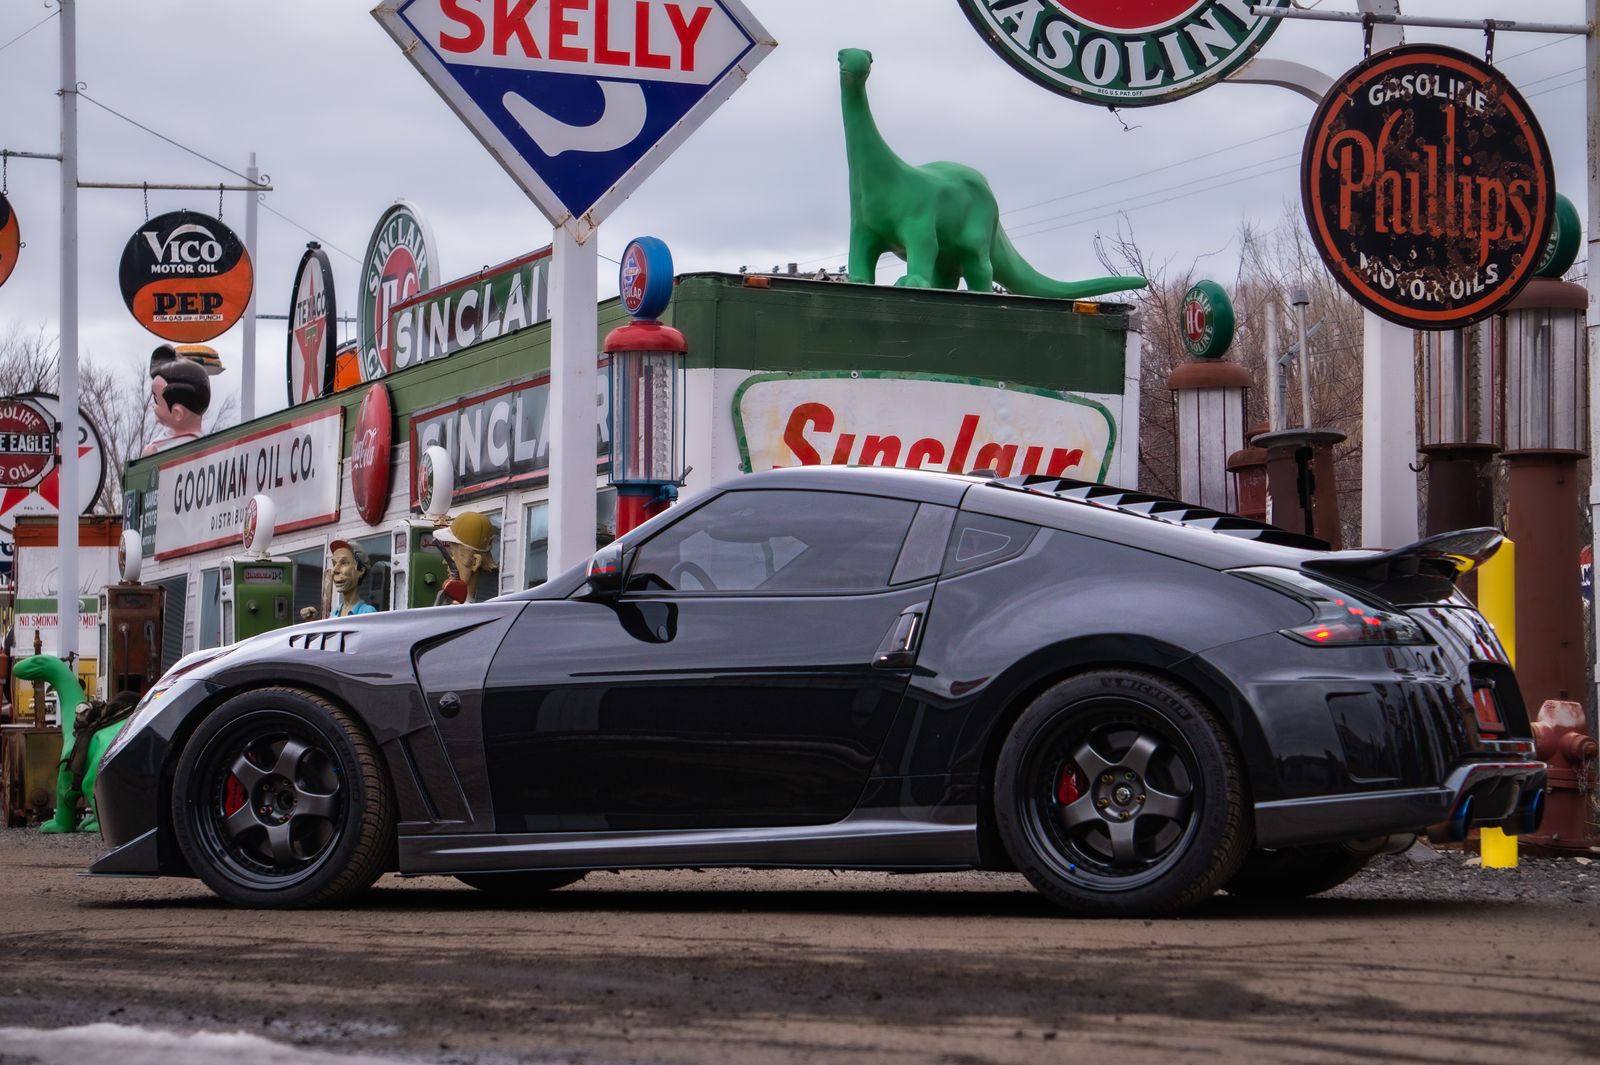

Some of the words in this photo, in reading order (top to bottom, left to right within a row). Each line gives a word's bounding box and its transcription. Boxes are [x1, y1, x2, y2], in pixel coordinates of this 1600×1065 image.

[439, 0, 712, 72] SKELLY
[988, 0, 1254, 88] ASOLIN
[1326, 103, 1531, 267] Phillips
[151, 264, 194, 273] MOTOR
[198, 264, 218, 273] OIL
[369, 218, 427, 297] SINCLAIR
[152, 292, 223, 315] PEP
[298, 291, 326, 324] TEXACO
[395, 262, 551, 369] SINCLAI
[10, 435, 50, 452] EAGLE
[773, 402, 1084, 479] Sinclair
[9, 463, 35, 480] OIL
[174, 453, 249, 515] GOODMAN
[256, 444, 284, 492] OIL
[290, 434, 315, 485] CO.
[211, 506, 250, 531] DISTRIBU
[20, 616, 29, 626] NO
[32, 615, 58, 626] SMOKIN
[83, 615, 99, 626] MOT
[1120, 679, 1190, 717] MICHELIN
